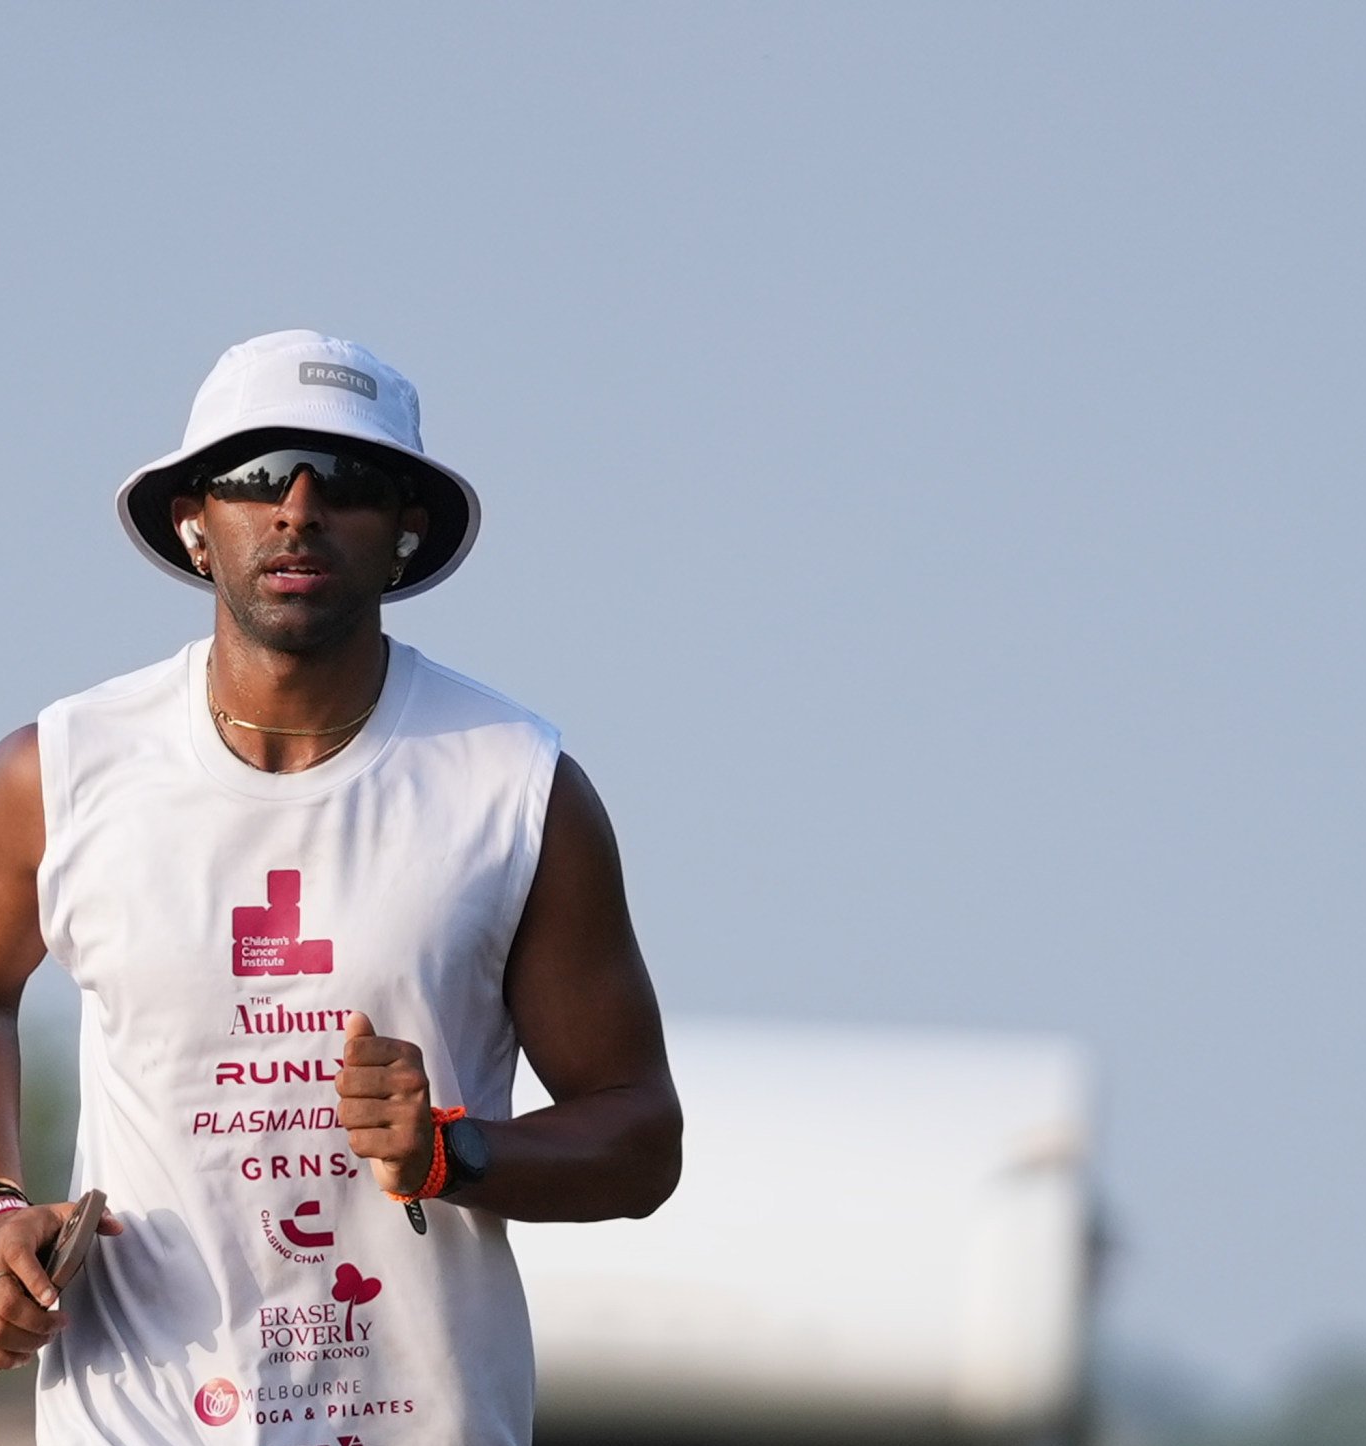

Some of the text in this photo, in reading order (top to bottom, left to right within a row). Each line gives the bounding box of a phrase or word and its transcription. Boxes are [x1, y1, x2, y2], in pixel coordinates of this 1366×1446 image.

[307, 368, 371, 392] FRACTEL
[242, 936, 290, 946] Children's
[242, 947, 278, 957] Cancer
[242, 957, 285, 967] Institute
[250, 996, 272, 1005] THE
[216, 1059, 344, 1085] RUNL
[261, 1209, 324, 1264] CHASING CHAI
[260, 1304, 336, 1327] ERASE
[269, 1346, 369, 1364] (HONG KONG)
[241, 1379, 362, 1402] MELBOURNE
[305, 1407, 315, 1420] &
[328, 1400, 414, 1418] PILATES
